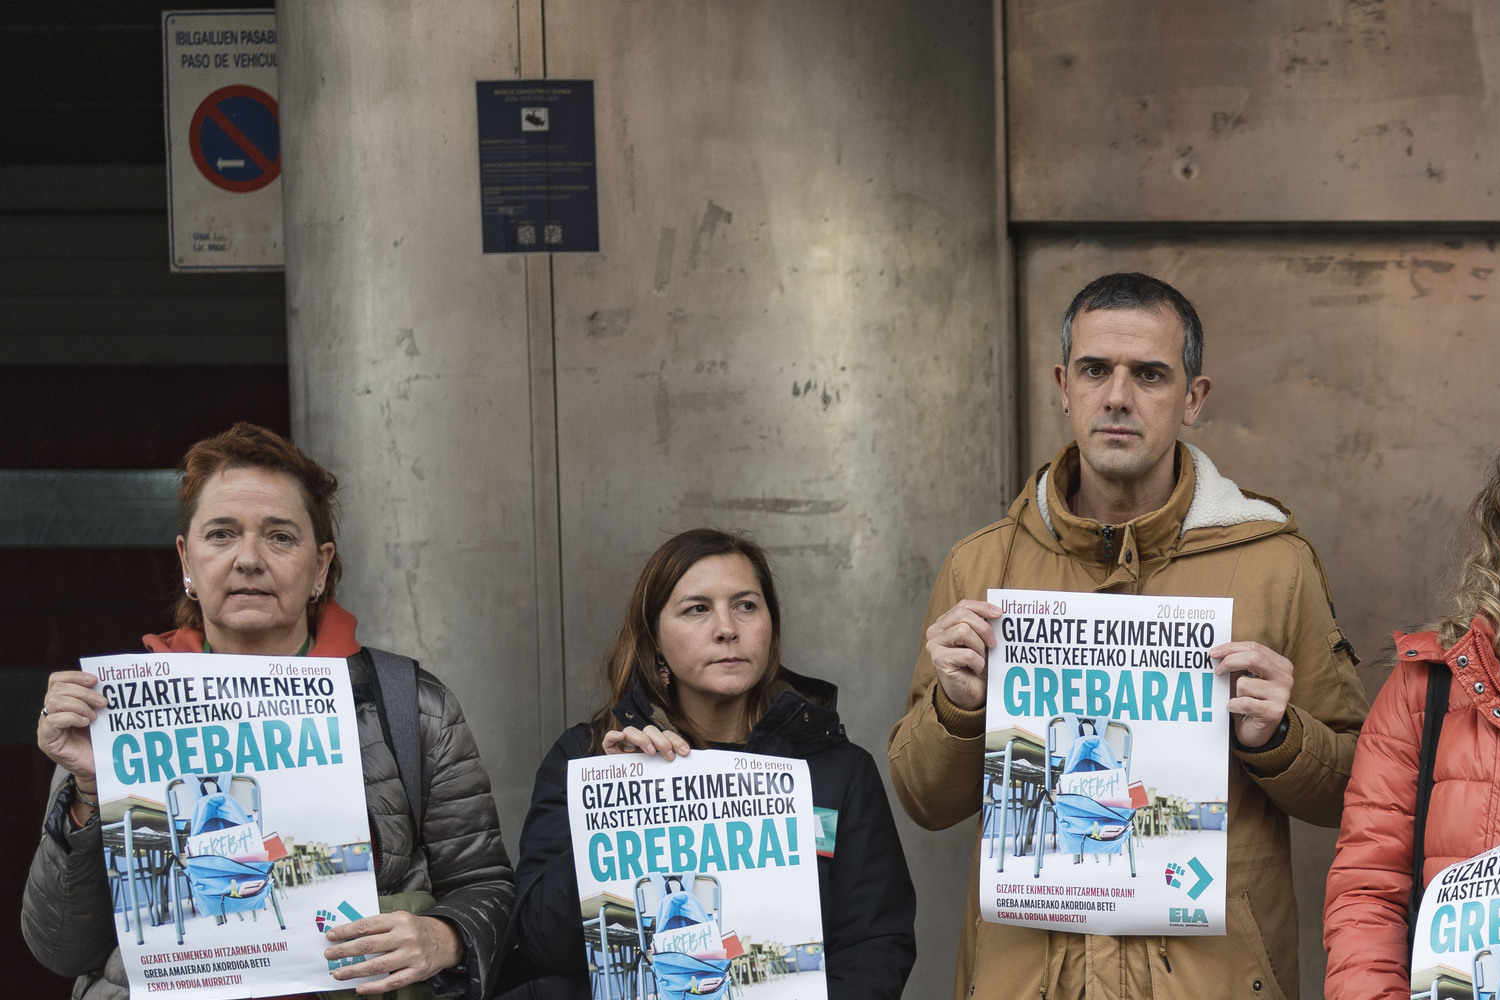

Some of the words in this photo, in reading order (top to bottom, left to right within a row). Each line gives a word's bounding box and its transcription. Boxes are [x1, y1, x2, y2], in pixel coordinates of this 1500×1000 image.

[176, 30, 238, 45] IBILGAILUEN
[241, 30, 277, 45] PASABI
[182, 54, 210, 68] PASO
[215, 54, 229, 67] DE
[233, 53, 278, 67] VEHICUL
[1001, 599, 1050, 615] Urtarrilak
[1053, 601, 1066, 615] 20
[1157, 605, 1170, 618] 20
[1173, 605, 1185, 619] de
[1188, 609, 1215, 620] enero
[1002, 617, 1087, 644] GIZARTE
[1094, 620, 1214, 648] EKIMENEKO
[1006, 646, 1126, 666] IKASTETXEETAKO
[1131, 649, 1213, 669] LANGILEOK
[98, 663, 152, 682] Urtarrilak
[156, 662, 170, 675] 20
[268, 663, 283, 675] 20
[286, 664, 299, 675] de
[102, 677, 197, 710] GIZARTE
[203, 677, 334, 701] EKIMENEKO
[1003, 666, 1213, 722] GREBARA!
[109, 702, 242, 732] IKASTETXEETAKO
[247, 699, 337, 718] LANGILEOK
[112, 717, 343, 785] GREBARA!
[581, 763, 627, 782] Urtarrilak
[630, 763, 643, 777] 20
[734, 758, 747, 770] 20
[750, 758, 762, 770] de
[765, 761, 792, 771] enero
[582, 778, 666, 810] GIZARTE
[672, 772, 794, 802] EKIMENEKO
[1068, 773, 1119, 798] GREBA!
[586, 803, 708, 830] IKASTETXEETAKO
[712, 797, 796, 820] LANGILEOK
[198, 827, 255, 855] GREBA!
[588, 817, 800, 882] GREBARA!
[997, 884, 1025, 894] GIZARTE
[1027, 885, 1064, 895] EKIMENEKO
[1065, 887, 1109, 897] HITZARMENA
[1110, 888, 1135, 898] ORAIN!
[997, 899, 1019, 908] GREBA
[1020, 900, 1059, 909] AMAIERAKO
[1060, 900, 1096, 910] AKORDIOA
[1097, 902, 1115, 911] BETE!
[1169, 908, 1208, 923] ELA
[998, 912, 1023, 920] ESKOLA
[1024, 913, 1048, 922] ORDUA
[1049, 914, 1087, 923] MURRIZTU!
[662, 925, 713, 954] GREBA!
[141, 954, 171, 965] GIZARTE
[172, 949, 213, 962] EKIMENEKO
[214, 945, 261, 959] HITZARMENA
[262, 942, 288, 953] ORAIN!
[144, 967, 168, 979] GREBA
[169, 964, 211, 977] AMAIERAKO
[212, 961, 249, 972] AKORDIOA
[250, 958, 271, 968] BETE!
[148, 982, 175, 992] ESKOLA
[176, 979, 201, 989] ORDUA
[202, 975, 242, 987] MURRIZTU!
